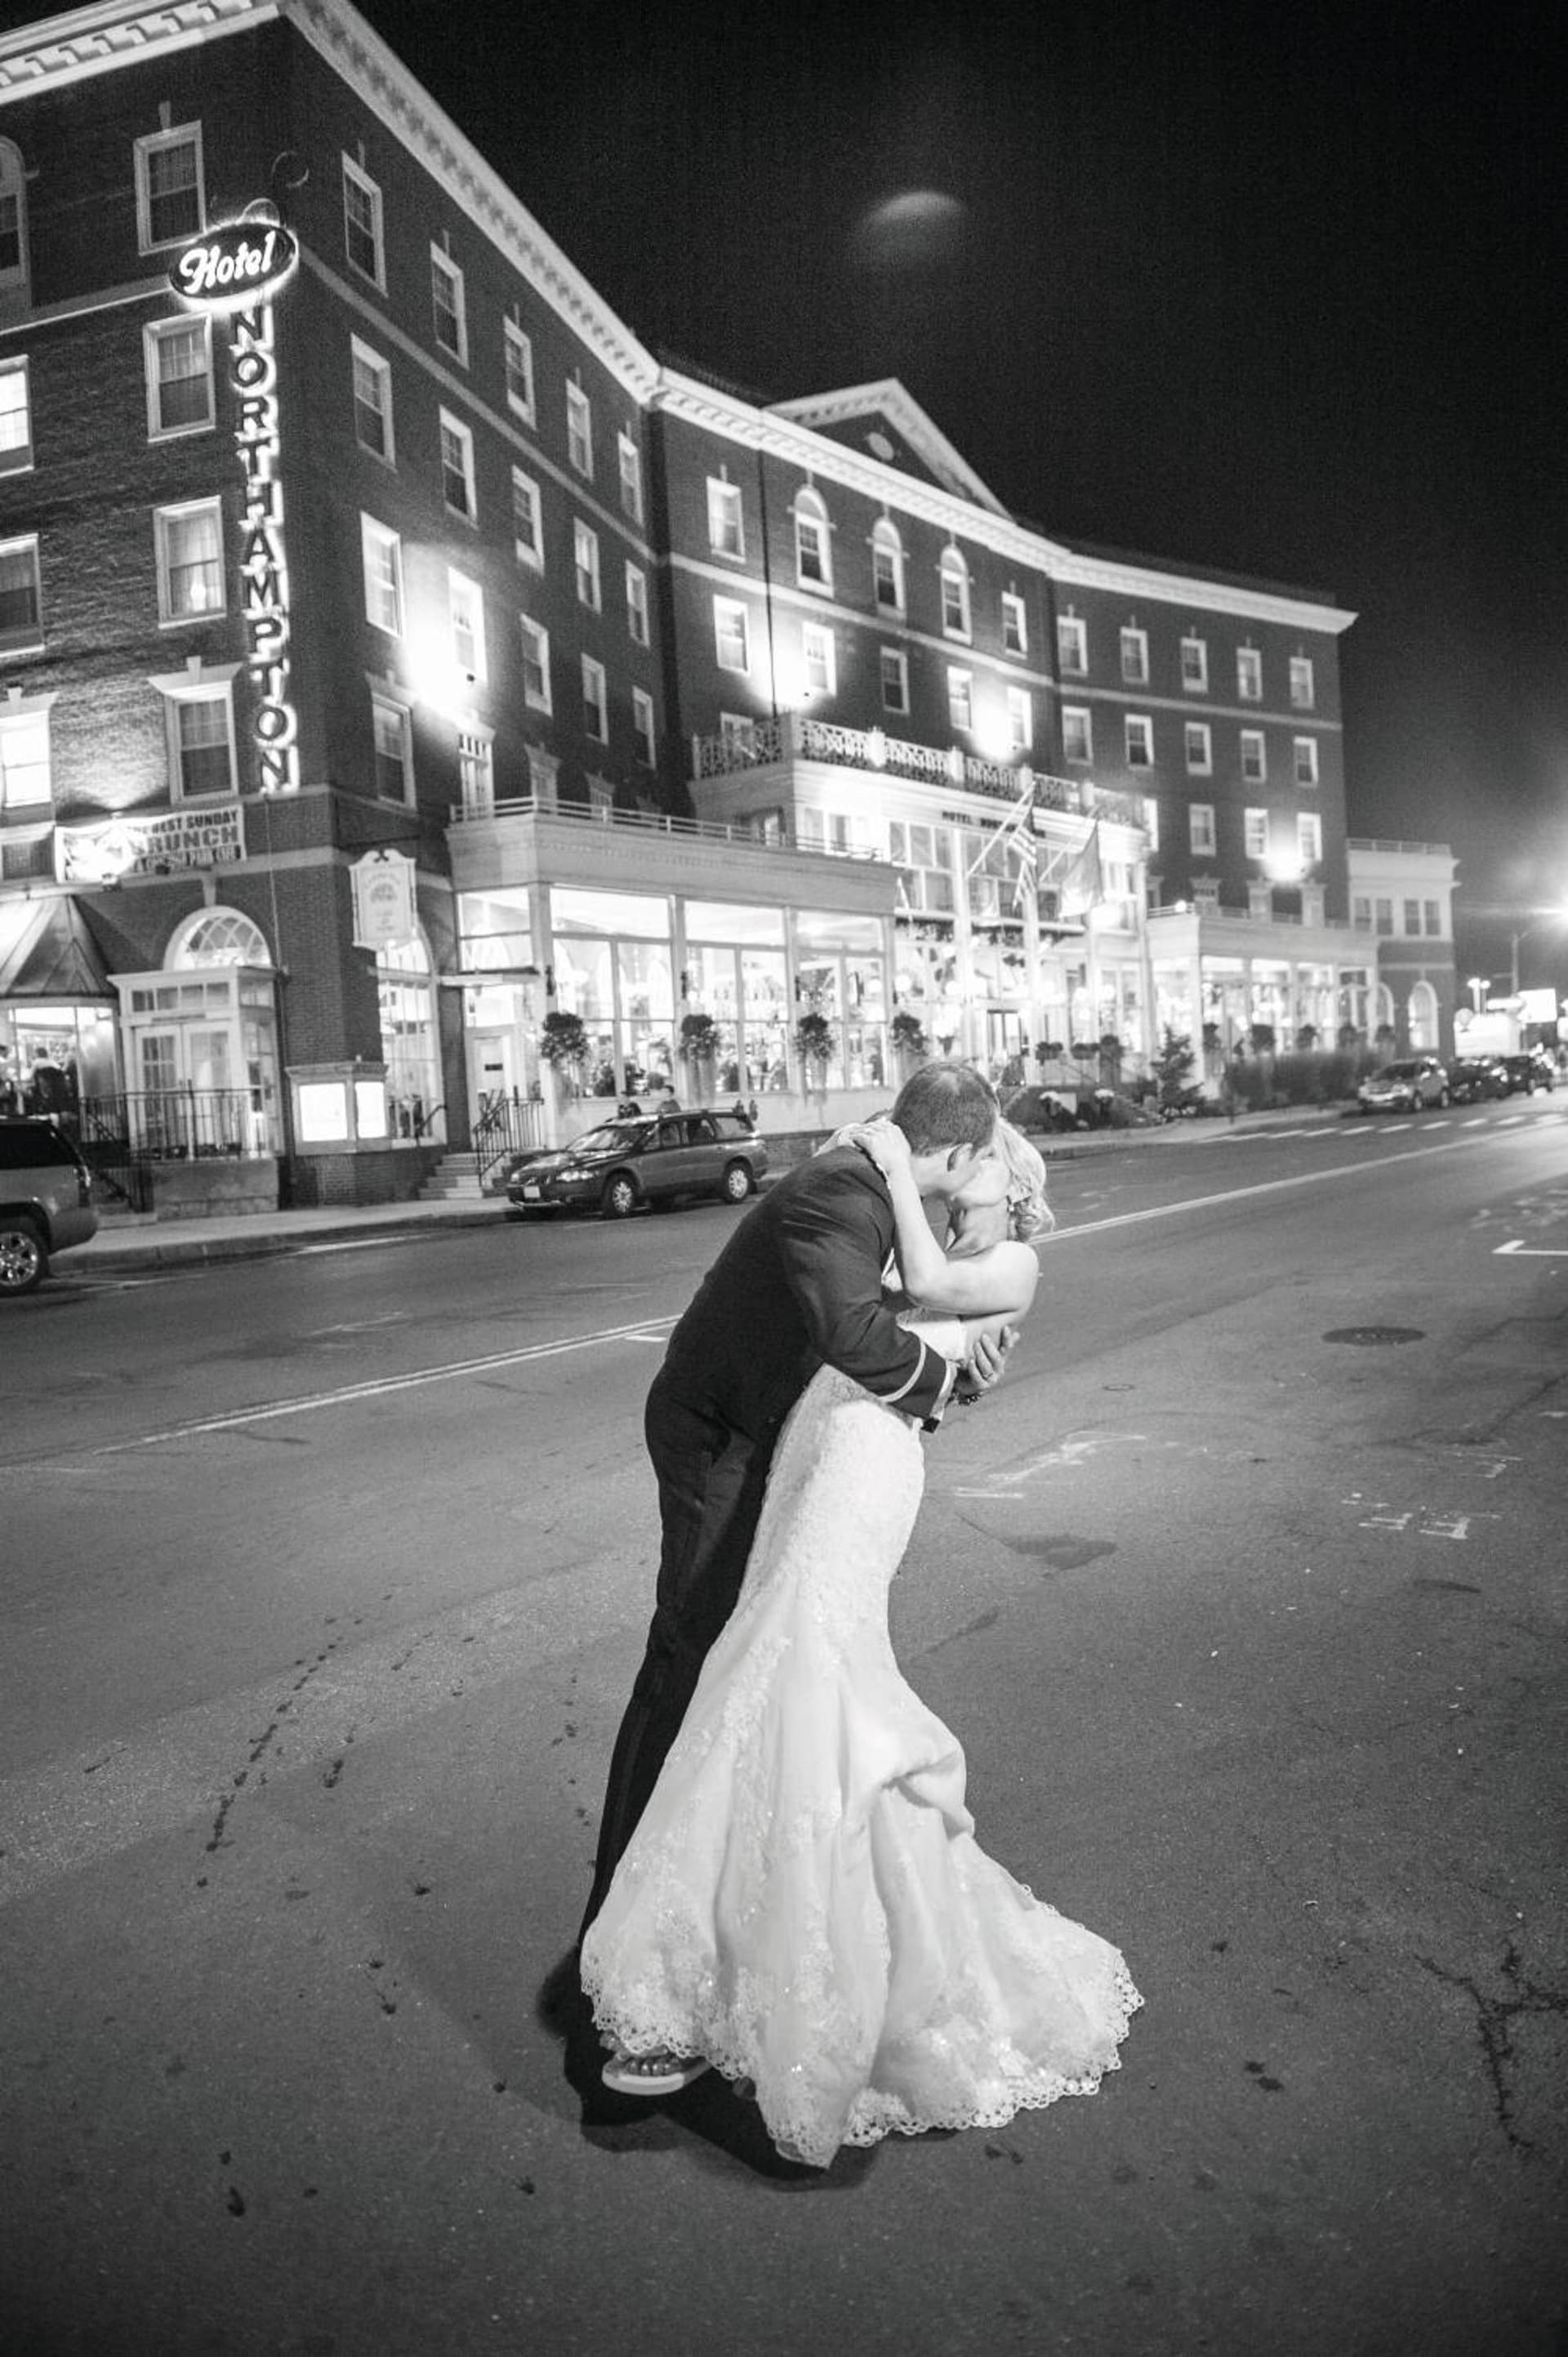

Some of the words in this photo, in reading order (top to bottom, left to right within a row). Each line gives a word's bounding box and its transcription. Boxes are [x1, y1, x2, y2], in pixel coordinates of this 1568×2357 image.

[180, 230, 275, 294] Hotel
[229, 304, 299, 793] NORTHAMPTON
[186, 811, 237, 829] SUNDAY
